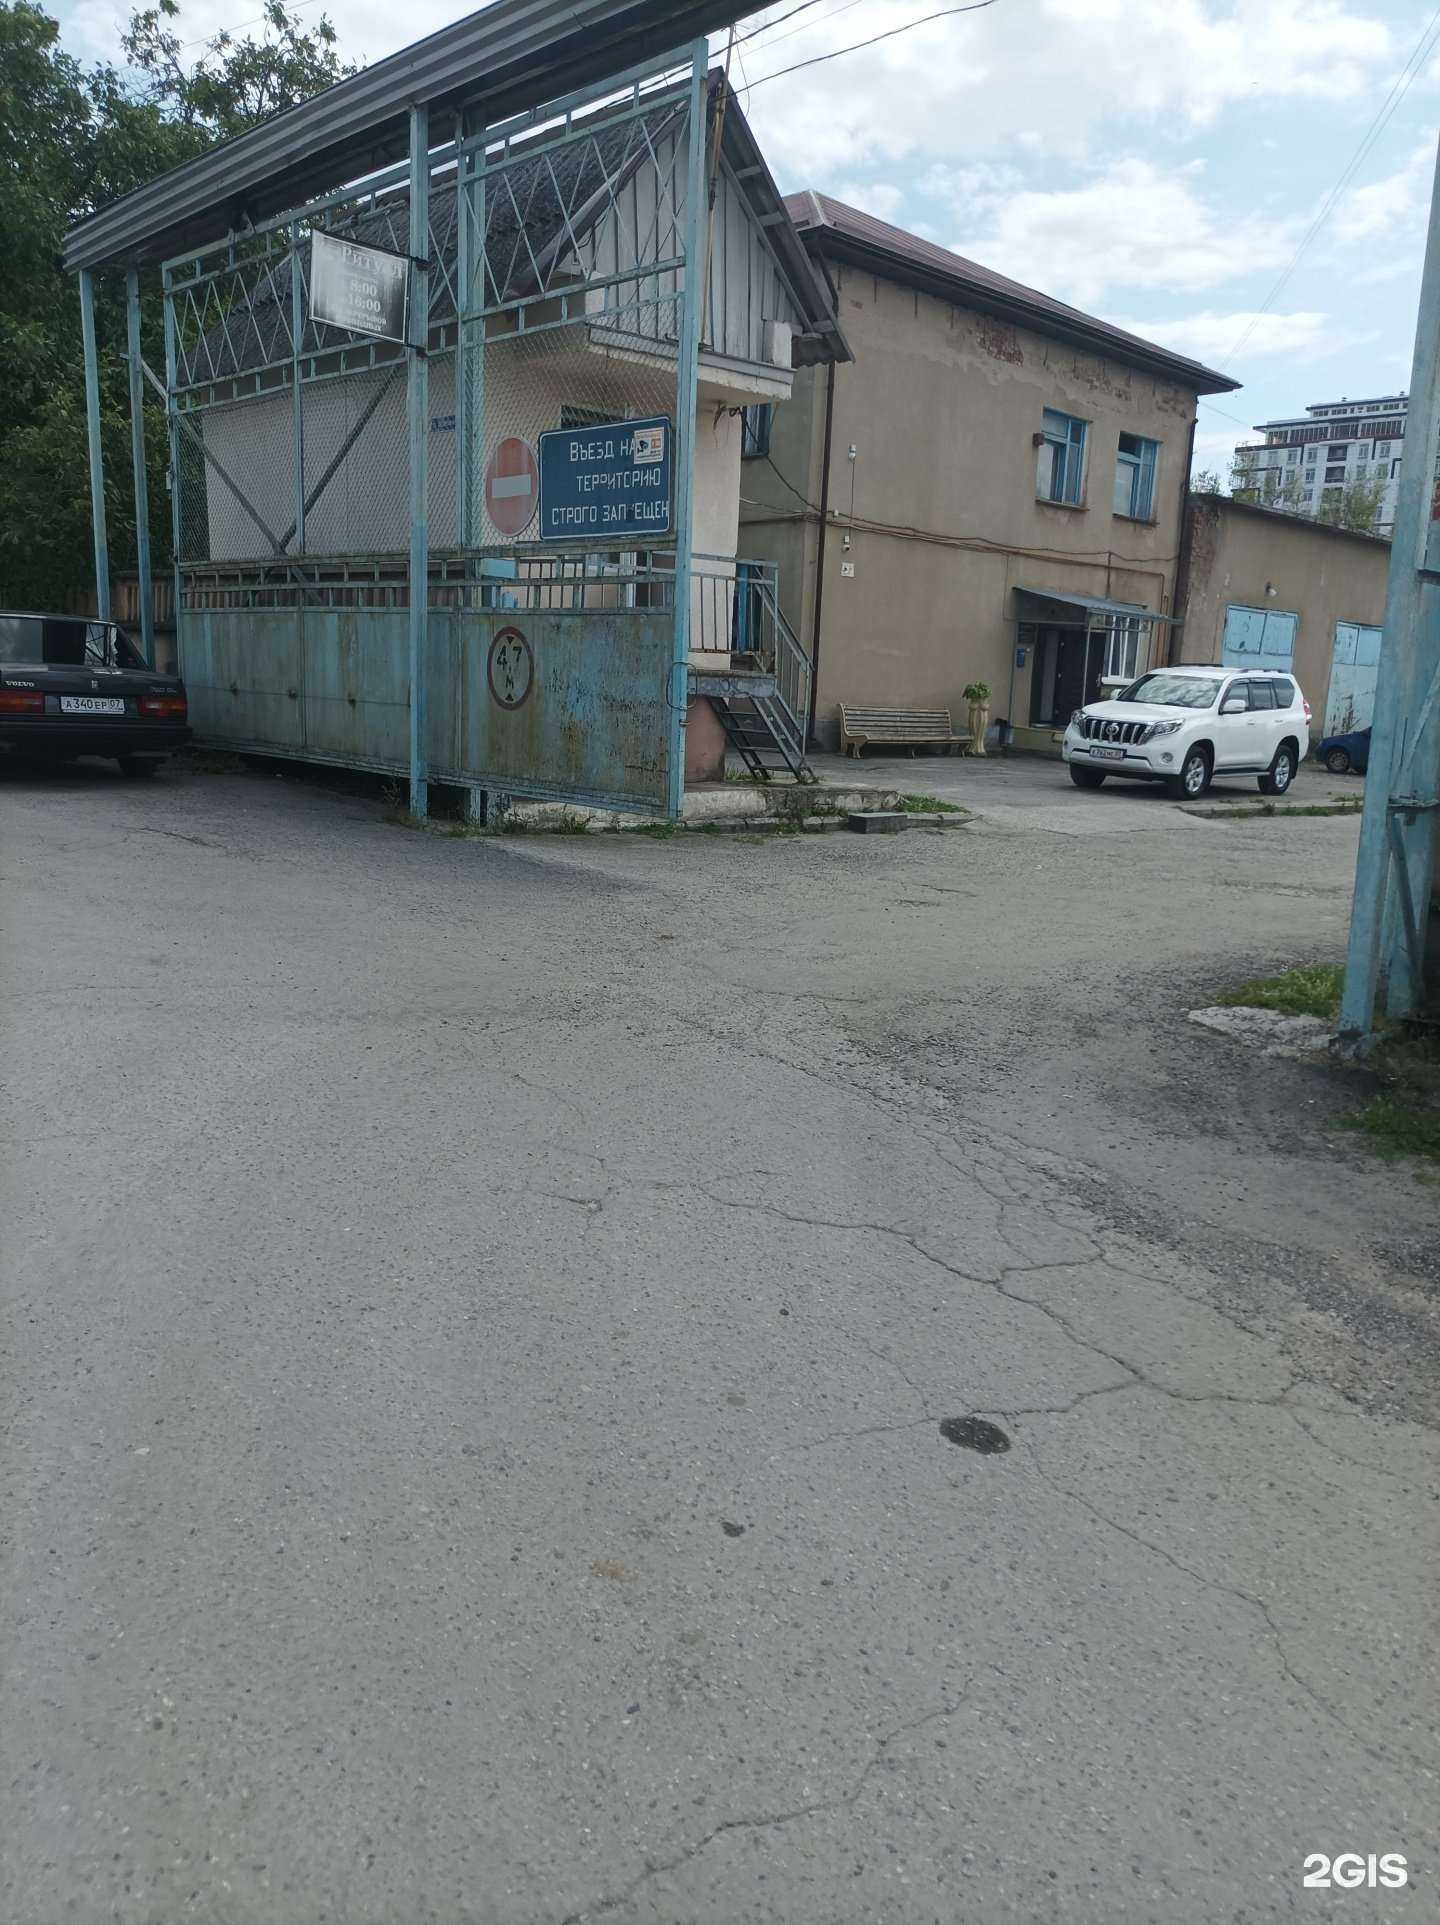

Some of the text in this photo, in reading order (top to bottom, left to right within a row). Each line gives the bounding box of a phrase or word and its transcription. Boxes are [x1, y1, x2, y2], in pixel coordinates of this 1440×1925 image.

[342, 246, 403, 279] Ритул
[350, 279, 377, 297] 8:00
[570, 440, 615, 461] ВЪЕЗД
[576, 468, 661, 493] ТЕРРИТОРИЮ
[552, 500, 670, 525] СТРОГО ЗАПЕЩЕН
[5, 680, 35, 688] VOLVO
